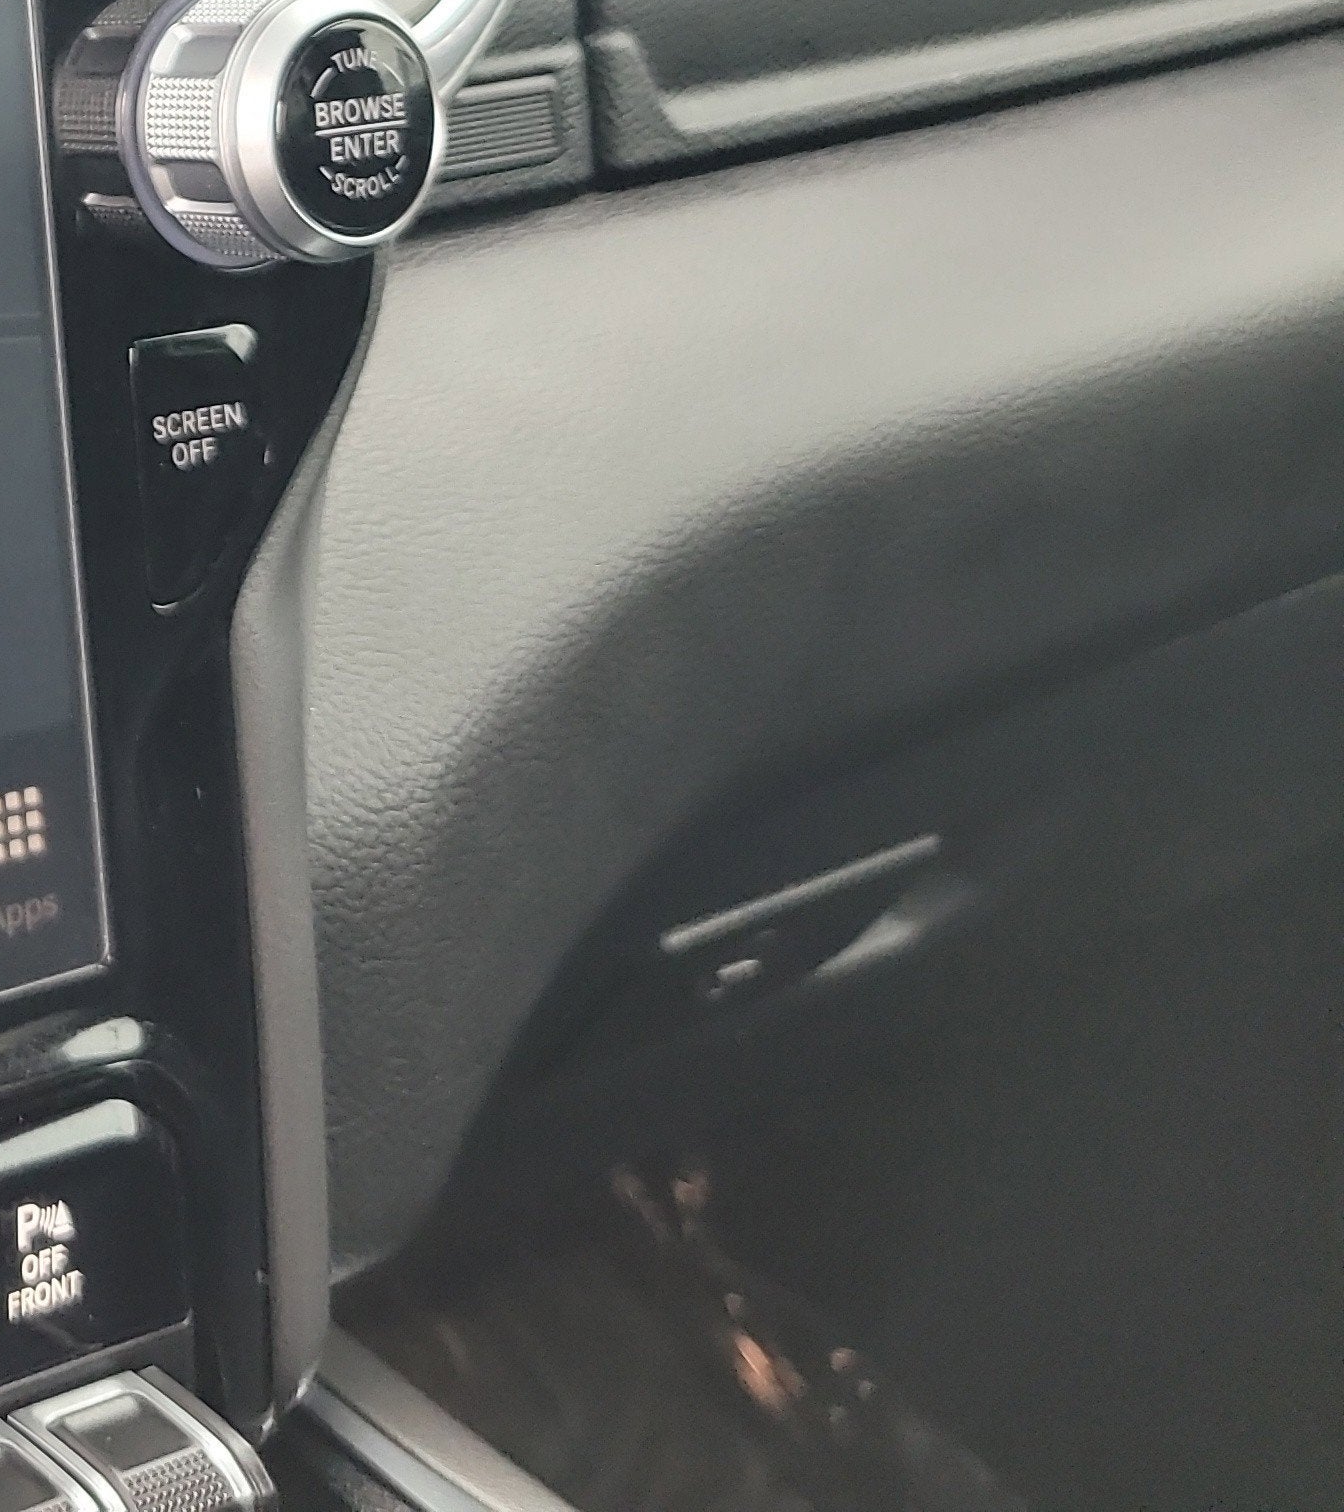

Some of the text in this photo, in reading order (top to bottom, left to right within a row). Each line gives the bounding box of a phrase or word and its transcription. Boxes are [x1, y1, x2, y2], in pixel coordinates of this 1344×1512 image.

[331, 48, 378, 73] TUNE
[315, 93, 407, 126] BROWSE
[330, 130, 400, 162] ENTER
[332, 168, 400, 198] SCROLL
[153, 401, 246, 443] SCREEN
[172, 437, 216, 471] OFF
[20, 1244, 69, 1283] OFF
[8, 1270, 83, 1322] FRONT
